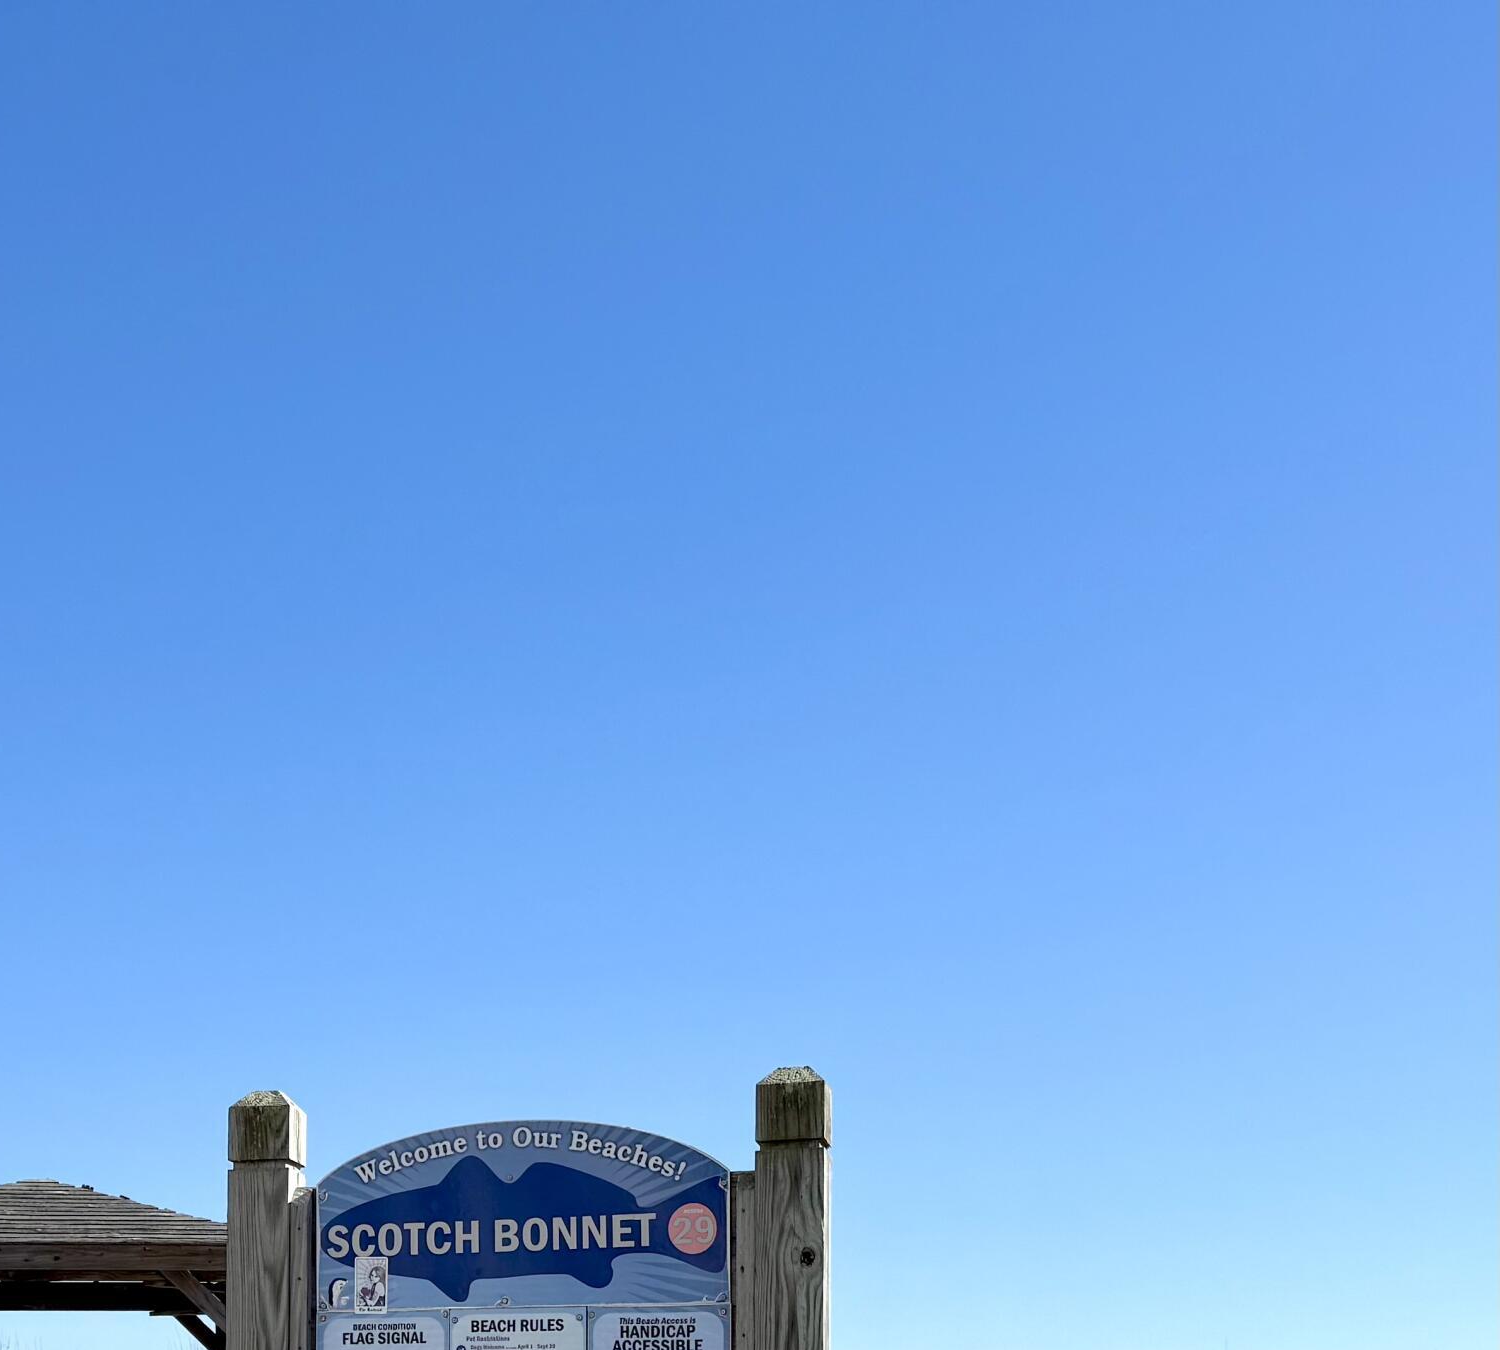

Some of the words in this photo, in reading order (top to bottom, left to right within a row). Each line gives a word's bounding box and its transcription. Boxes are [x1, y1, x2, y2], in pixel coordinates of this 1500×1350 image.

[354, 1136, 467, 1184] Welcome
[476, 1130, 503, 1149] to
[512, 1127, 562, 1148] Our
[569, 1130, 687, 1181] Beaches!
[326, 1220, 480, 1259] SCOTCH
[493, 1212, 657, 1253] BONNET
[673, 1216, 714, 1245] 29
[378, 1323, 417, 1331] CONDITION
[471, 1320, 516, 1332] BEACH
[520, 1319, 564, 1332] RULES
[619, 1317, 634, 1325] This
[636, 1317, 660, 1325] Beach
[661, 1317, 688, 1325] Access
[343, 1333, 375, 1345] FLAG
[377, 1332, 427, 1345] SIGNAL
[620, 1325, 696, 1339] HANDICAP
